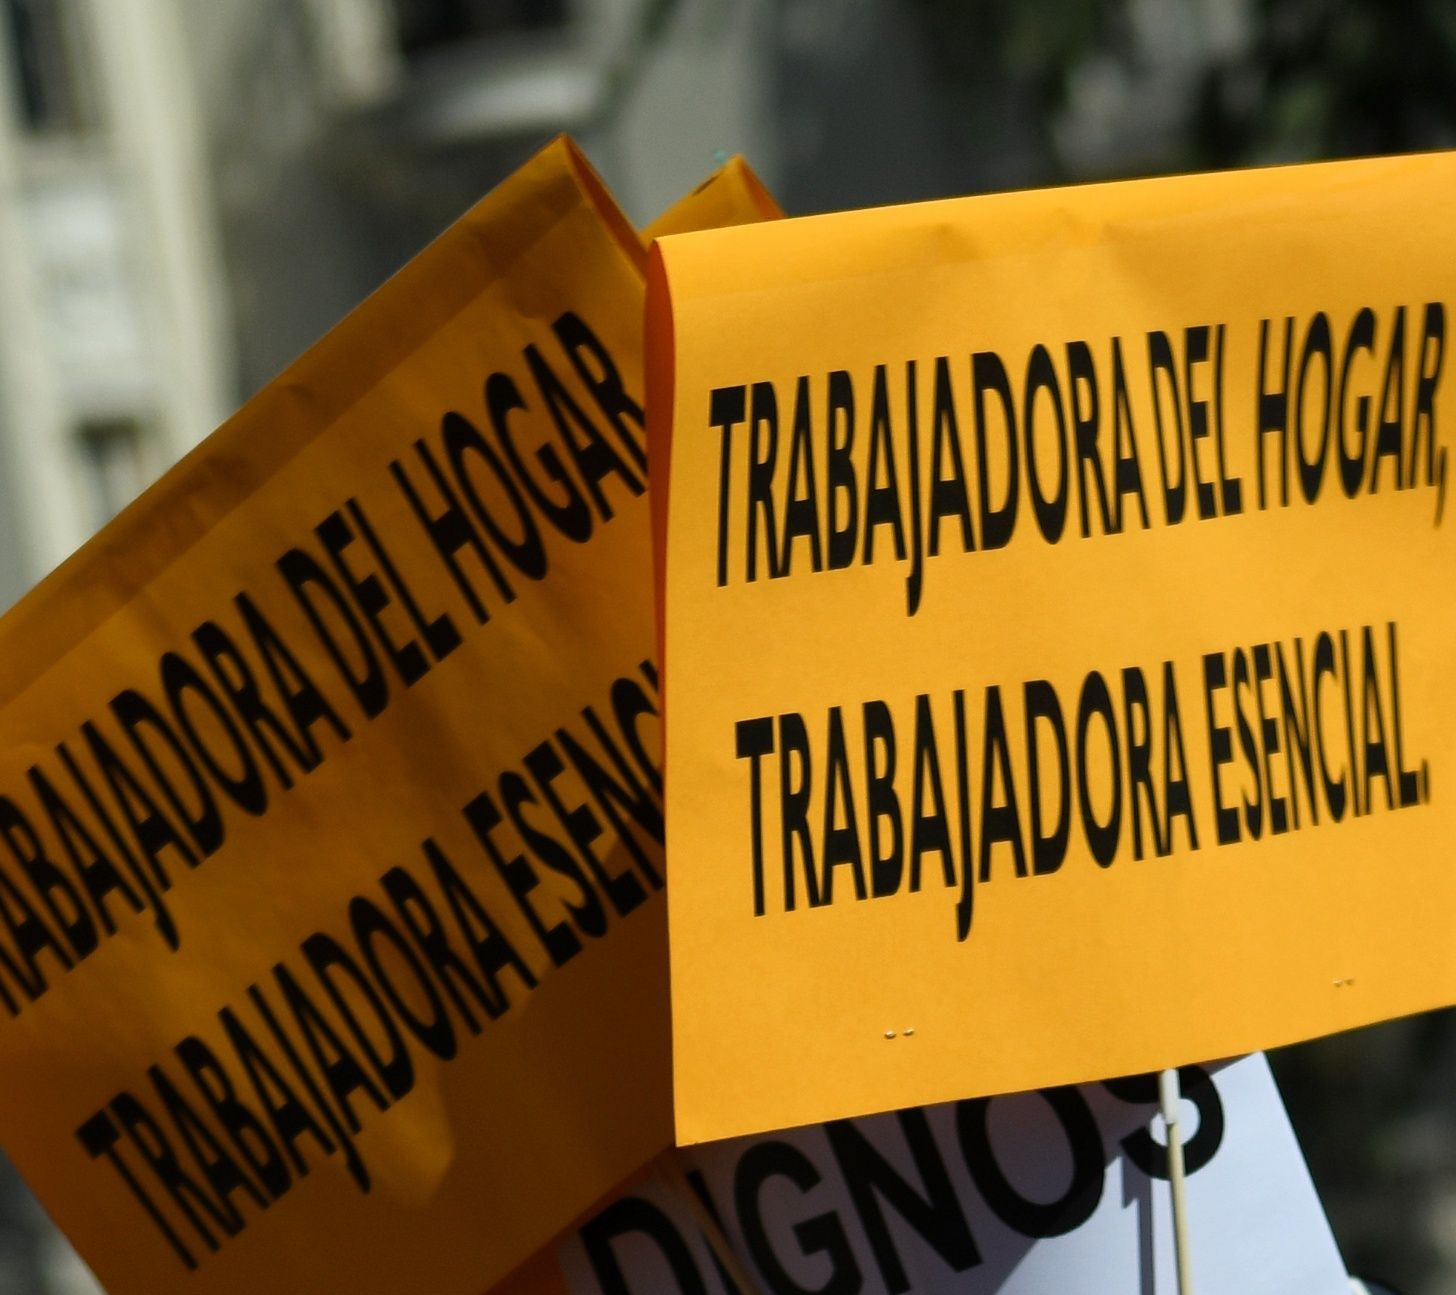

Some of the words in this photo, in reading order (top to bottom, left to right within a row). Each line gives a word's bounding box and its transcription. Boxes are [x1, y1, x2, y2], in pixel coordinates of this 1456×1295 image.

[277, 498, 463, 721] DEL
[709, 337, 1150, 617] TRABAJADORA
[1148, 324, 1242, 526] DEL
[1256, 302, 1448, 528] HOGAR,
[736, 660, 1199, 942] TRABAJADORA
[1205, 622, 1431, 846] ESENCIAL.
[76, 839, 542, 1271] TRABAJADORA
[461, 659, 665, 968] ESENC
